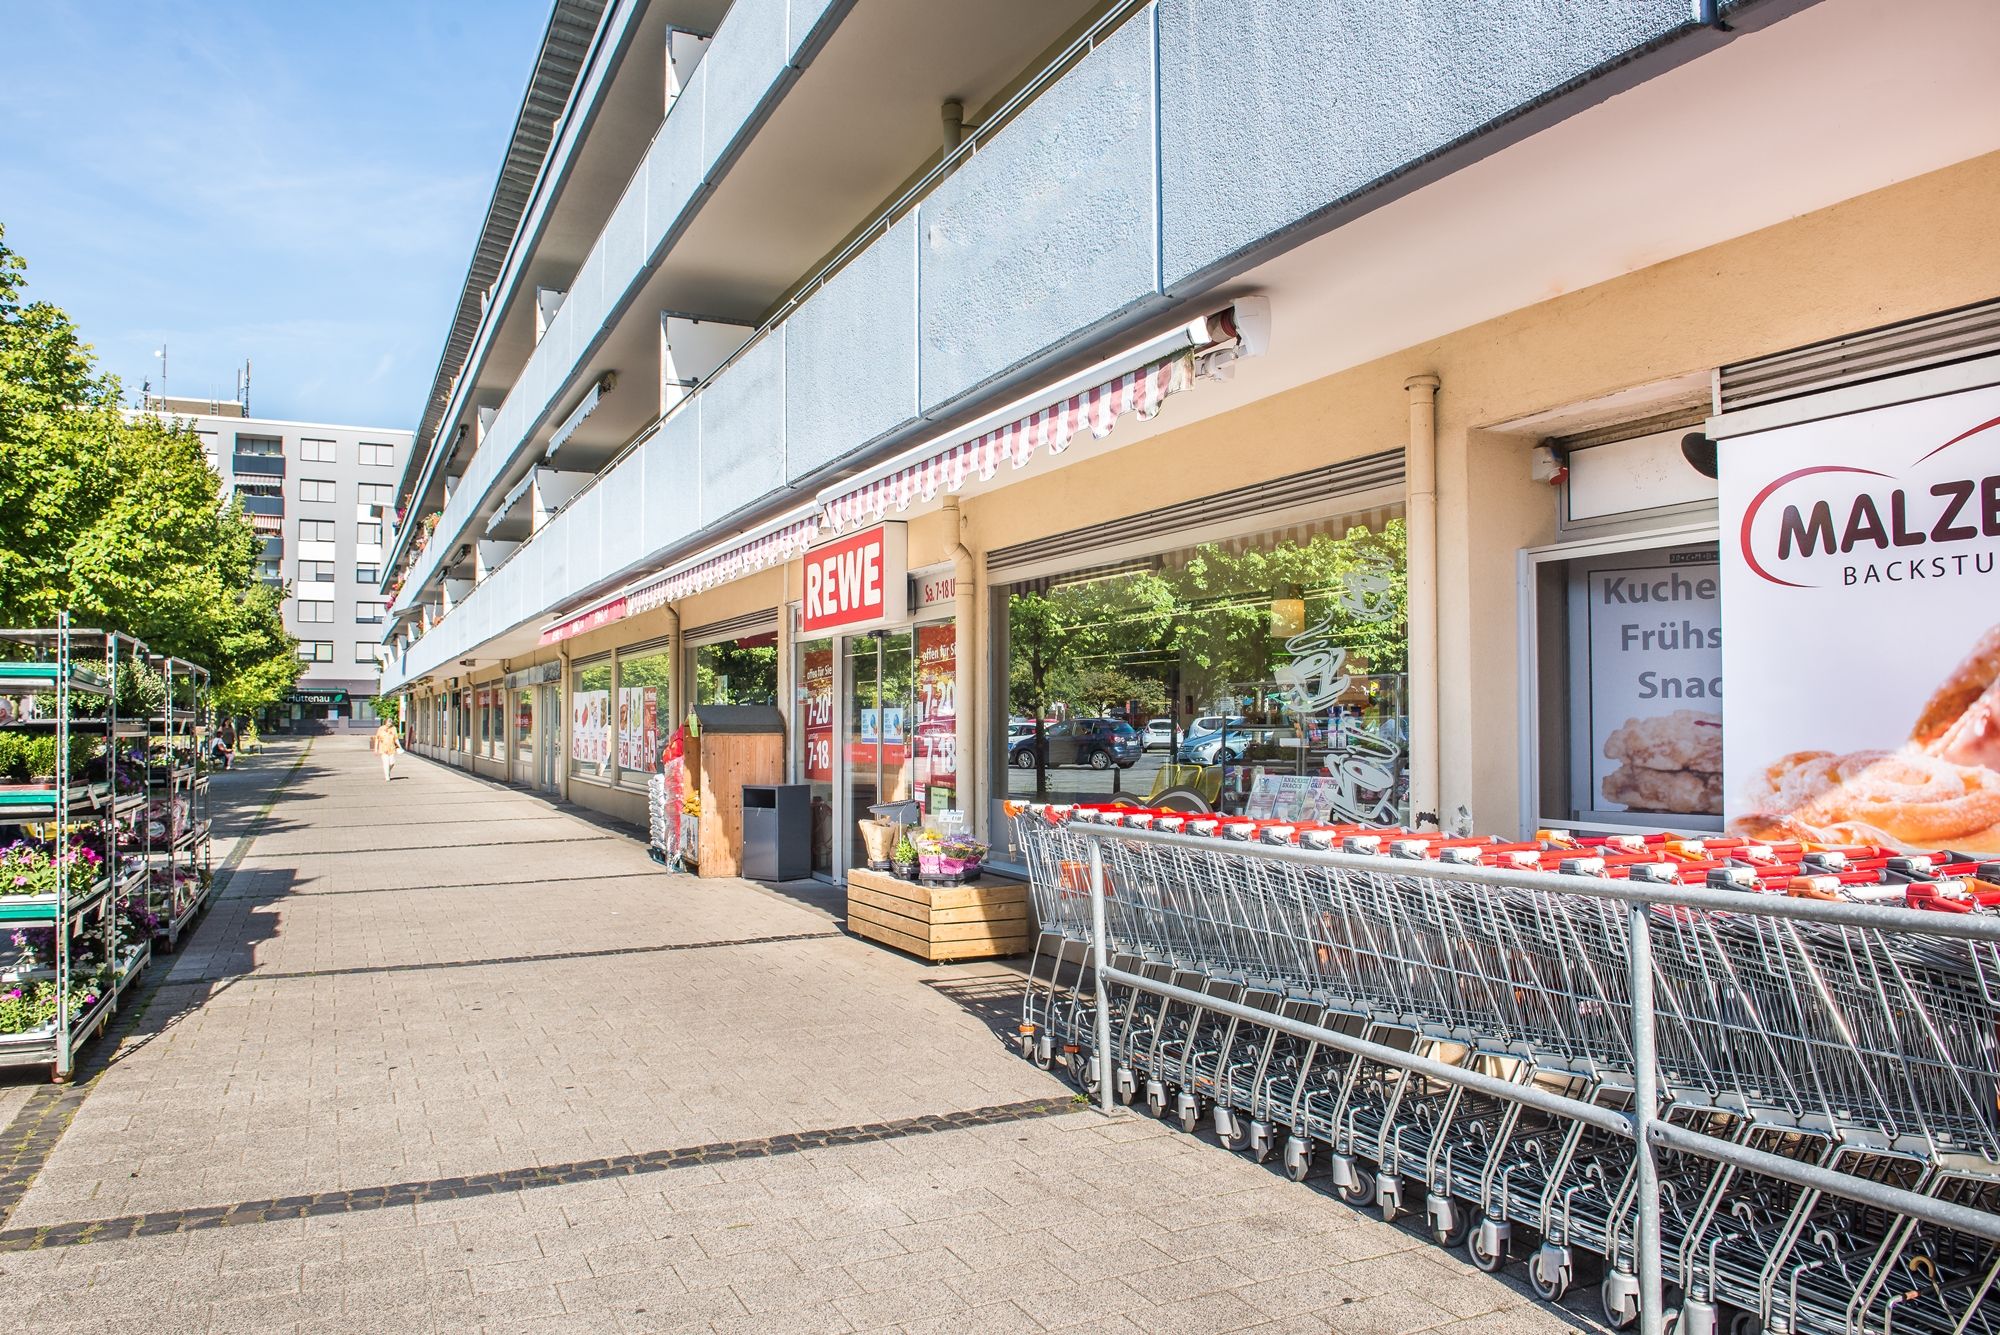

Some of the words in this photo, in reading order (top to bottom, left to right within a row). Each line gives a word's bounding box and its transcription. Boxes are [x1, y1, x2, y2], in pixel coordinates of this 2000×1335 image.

[806, 541, 881, 619] REWE
[1843, 551, 1994, 586] BACKSTU
[925, 584, 934, 603] Sa.
[935, 579, 950, 600] 7-18
[1603, 571, 1716, 605] Kuche
[1621, 620, 1722, 652] Frühs
[923, 647, 939, 662] offen
[922, 678, 956, 719] 7-20
[1638, 671, 1722, 700] Snac
[807, 693, 829, 726] 7-20
[807, 739, 830, 770] 7-18
[923, 736, 956, 774] 7-18
